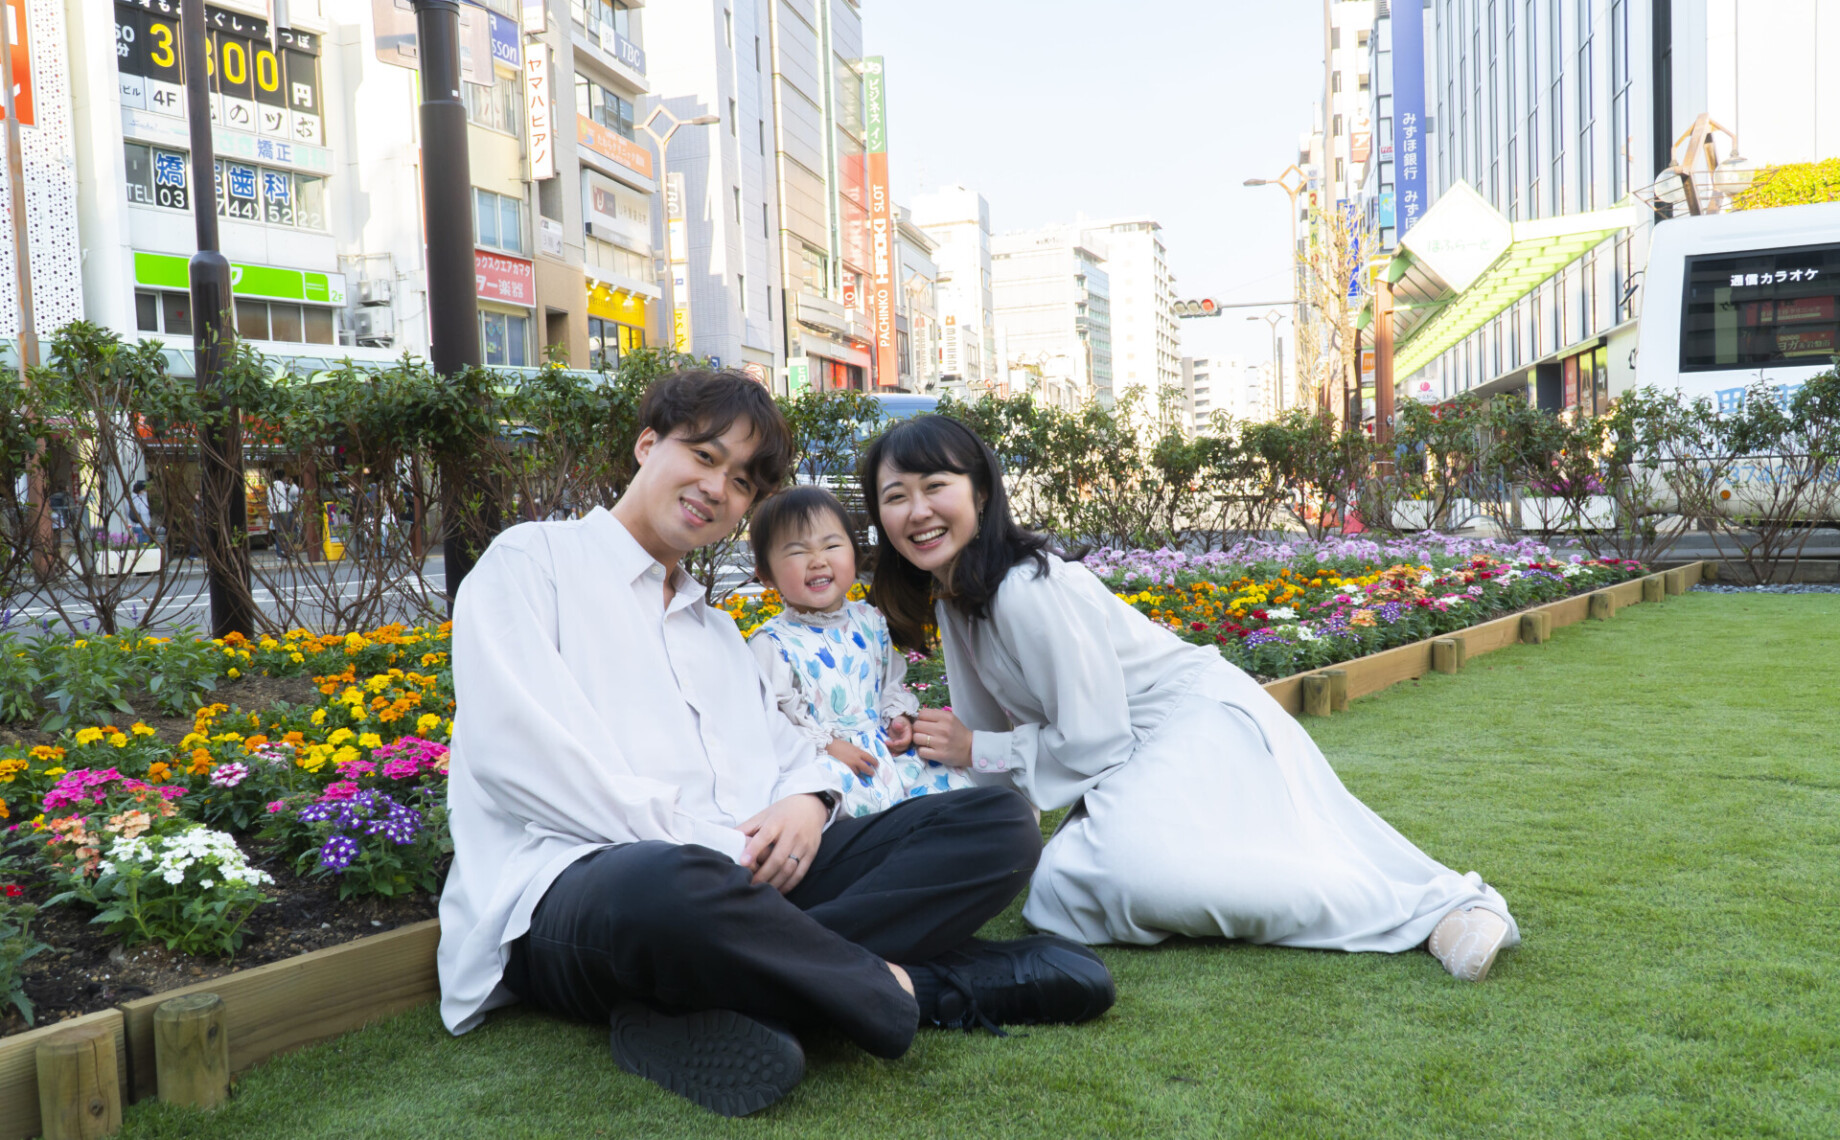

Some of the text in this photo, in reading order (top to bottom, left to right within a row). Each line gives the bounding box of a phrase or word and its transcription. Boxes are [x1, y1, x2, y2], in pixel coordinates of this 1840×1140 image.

[491, 38, 518, 63] sson
[620, 39, 641, 67] TBC
[119, 86, 177, 107] ビル 4F
[869, 78, 881, 124] ビジネス
[210, 101, 314, 138] のツボ
[528, 59, 546, 164] ヤマハピアノ
[870, 127, 882, 151] イン
[1402, 112, 1418, 181] みずほ銀行
[126, 183, 153, 203] TEL
[873, 184, 885, 213] SLOT
[475, 256, 531, 277] ックスクエアカマタ
[1730, 268, 1819, 286] 通信カラオケ
[331, 290, 344, 303] 2F
[475, 274, 524, 298] ター楽器
[878, 289, 890, 348] PACHINKO
